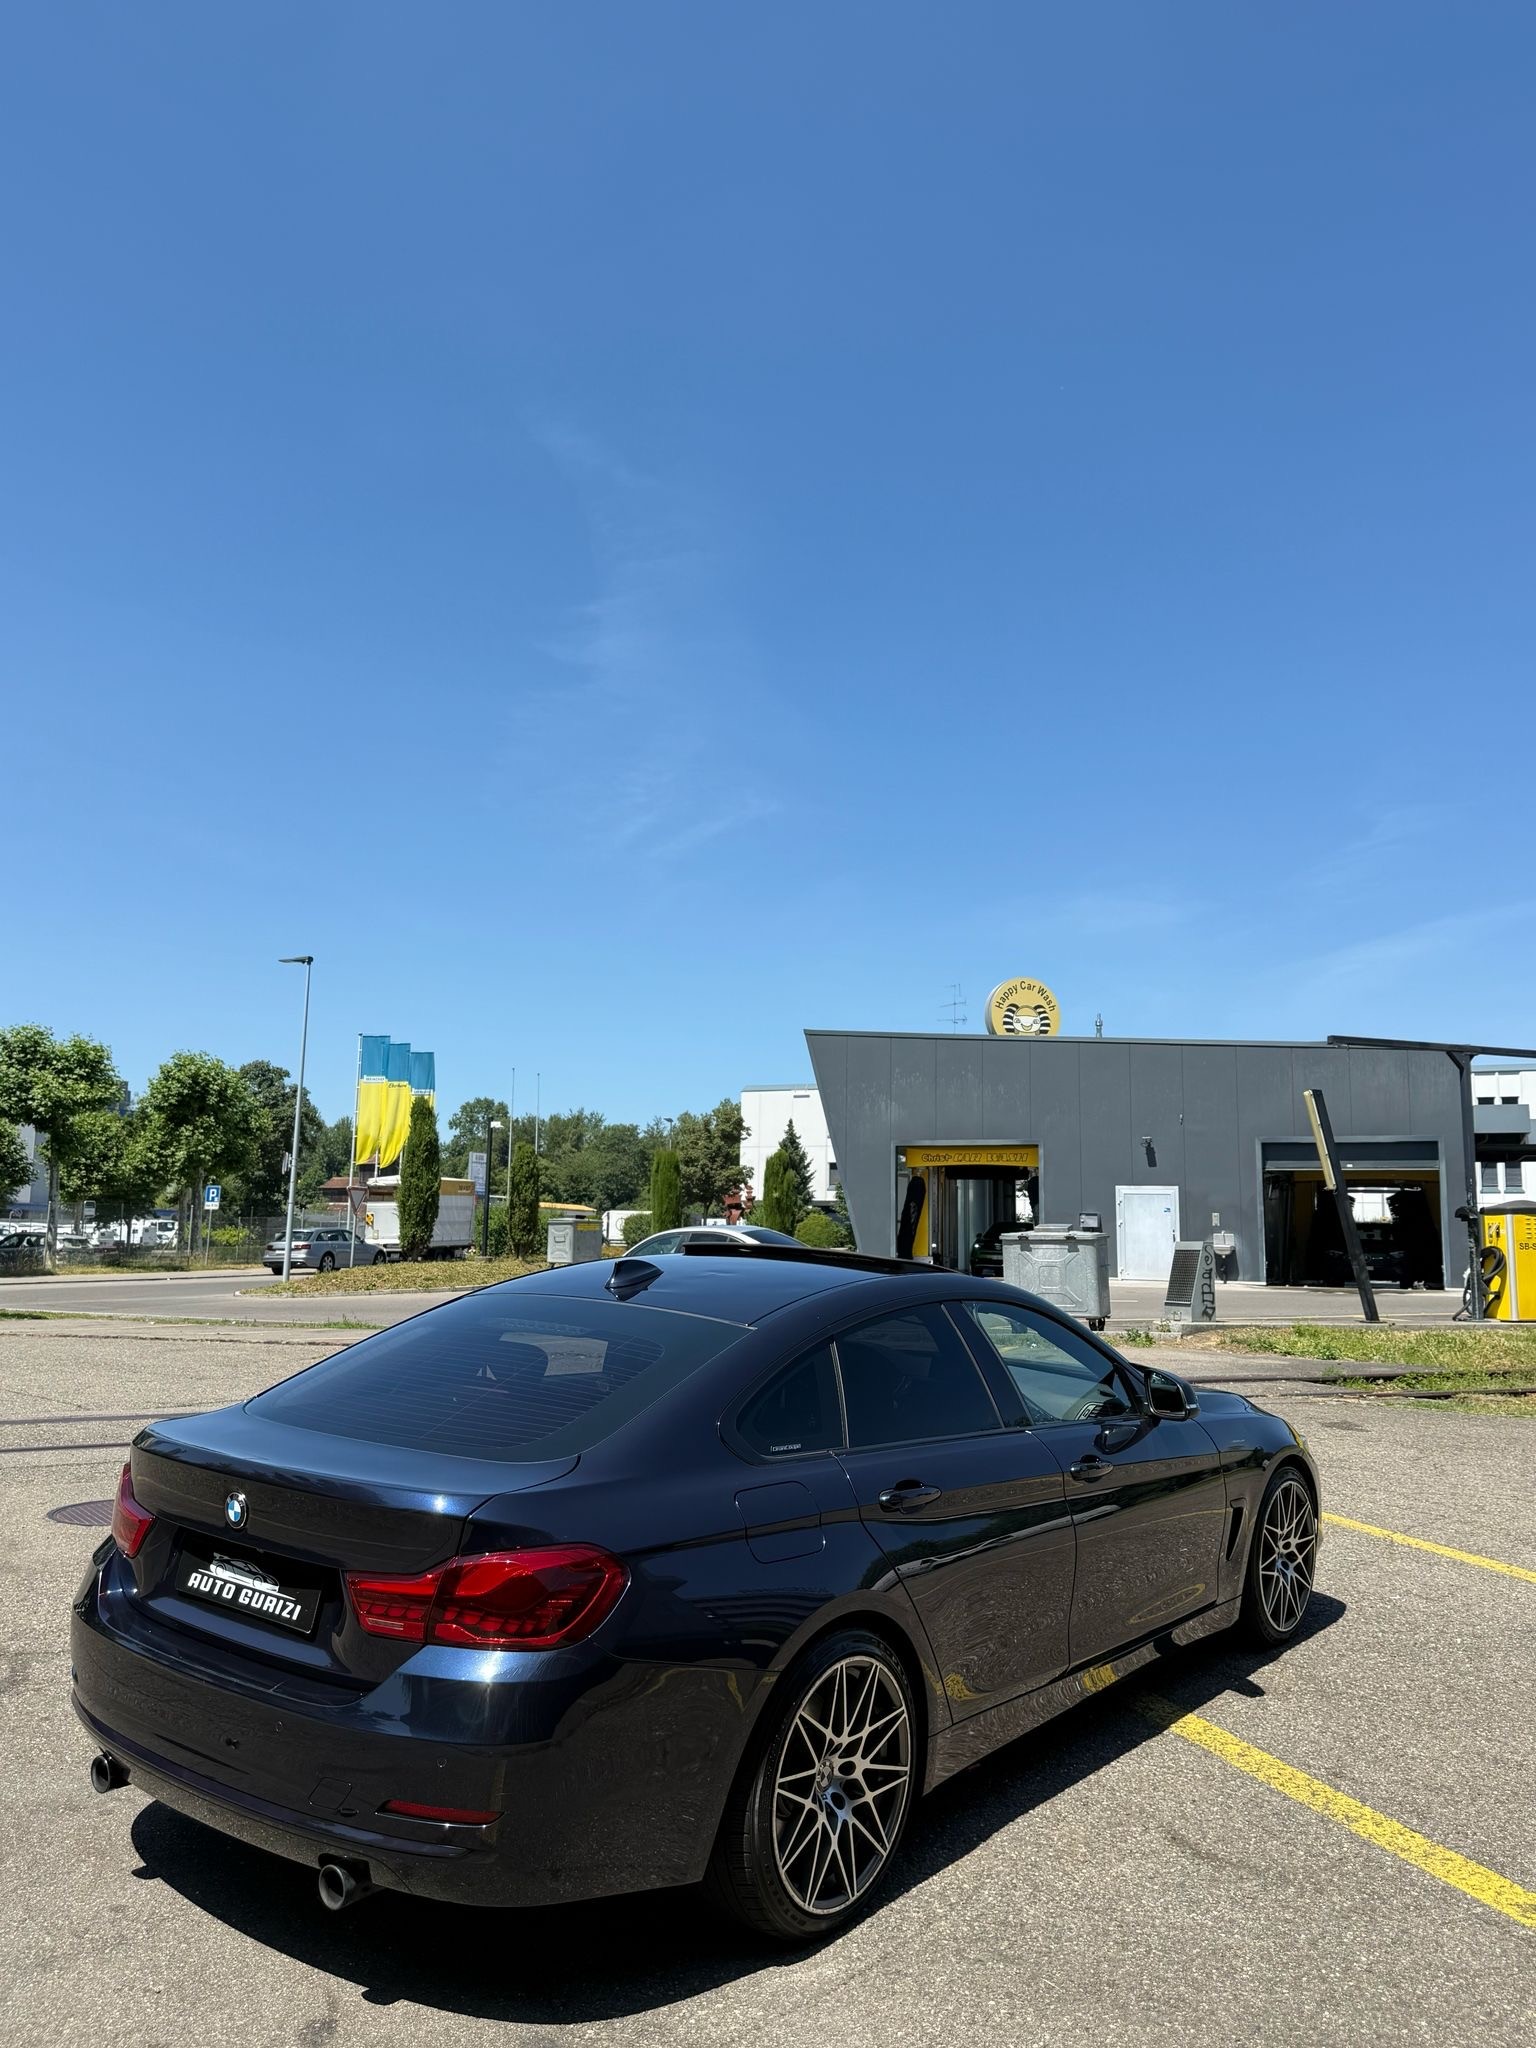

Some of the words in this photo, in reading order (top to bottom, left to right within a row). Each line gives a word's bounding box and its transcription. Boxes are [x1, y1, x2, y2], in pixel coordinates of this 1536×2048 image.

[995, 984, 1018, 1009] Happy
[1020, 981, 1036, 991] Car
[1037, 986, 1056, 1012] Wash
[953, 1153, 982, 1162] CAR
[986, 1152, 1028, 1162] WASH
[210, 1189, 217, 1200] P
[187, 1572, 236, 1599] AUTO
